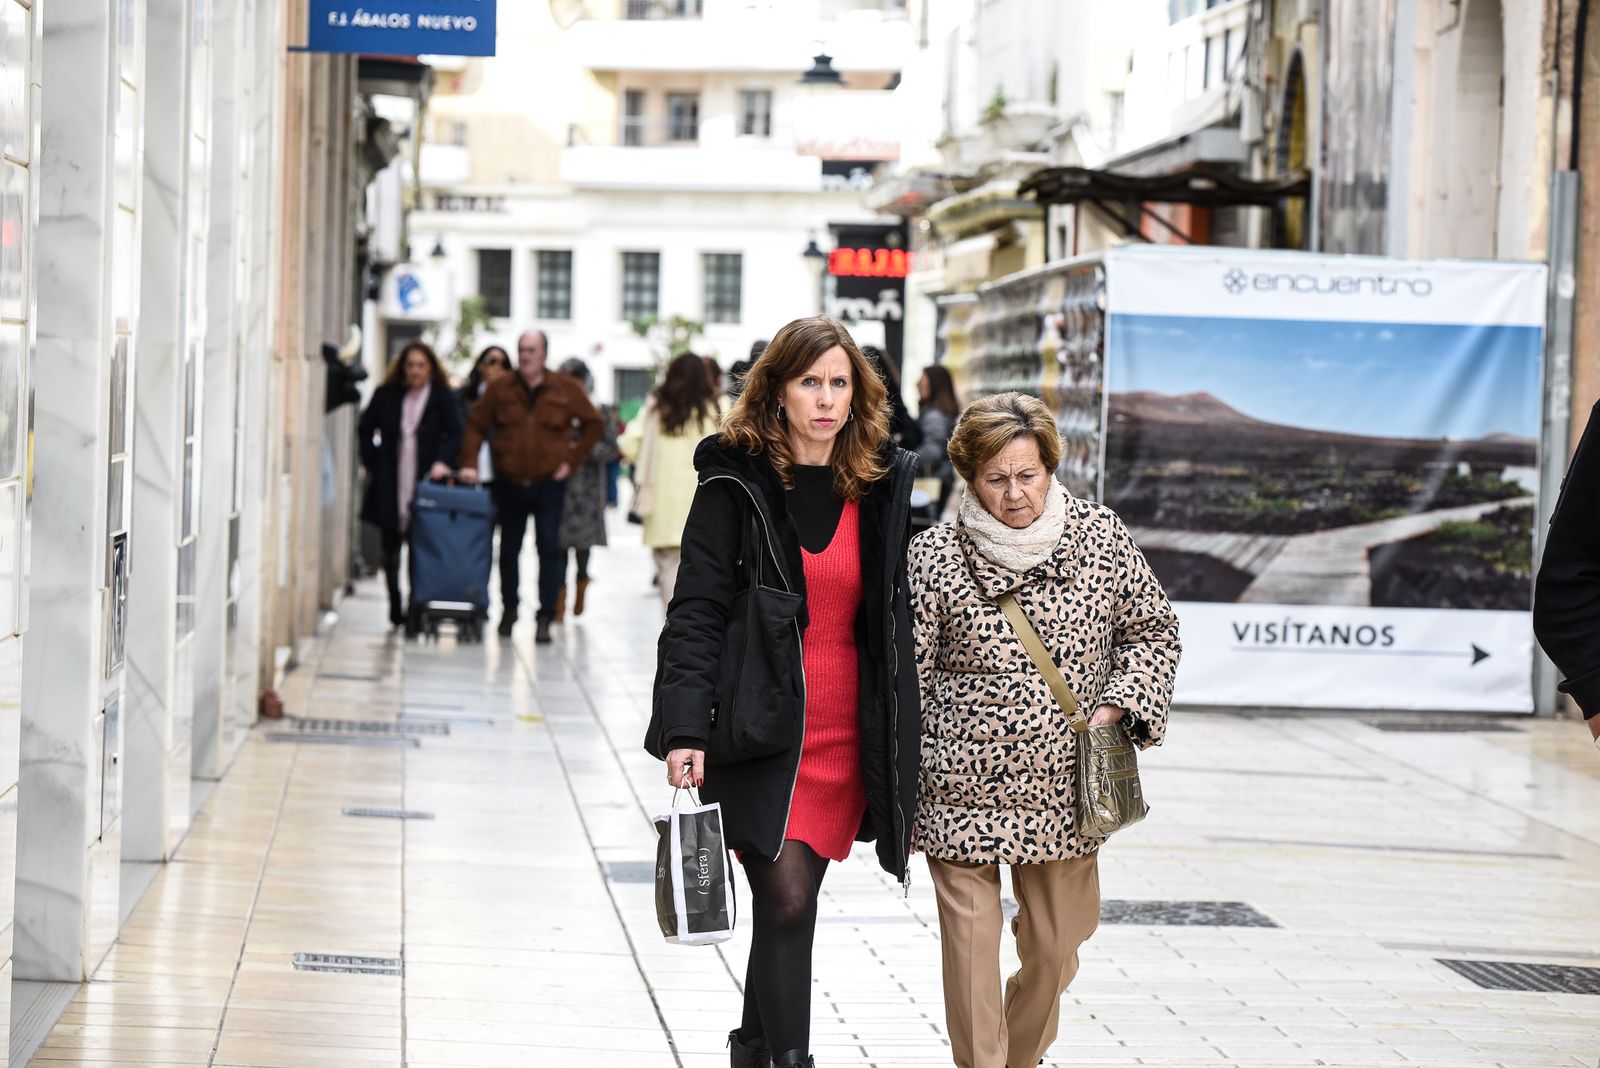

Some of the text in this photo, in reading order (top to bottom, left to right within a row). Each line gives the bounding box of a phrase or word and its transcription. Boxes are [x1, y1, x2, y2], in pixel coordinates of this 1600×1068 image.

[351, 8, 411, 29] ÁBALOS
[417, 14, 478, 32] NUEVO
[1252, 273, 1433, 296] encuentro
[1231, 616, 1395, 647] VISÍTANOS
